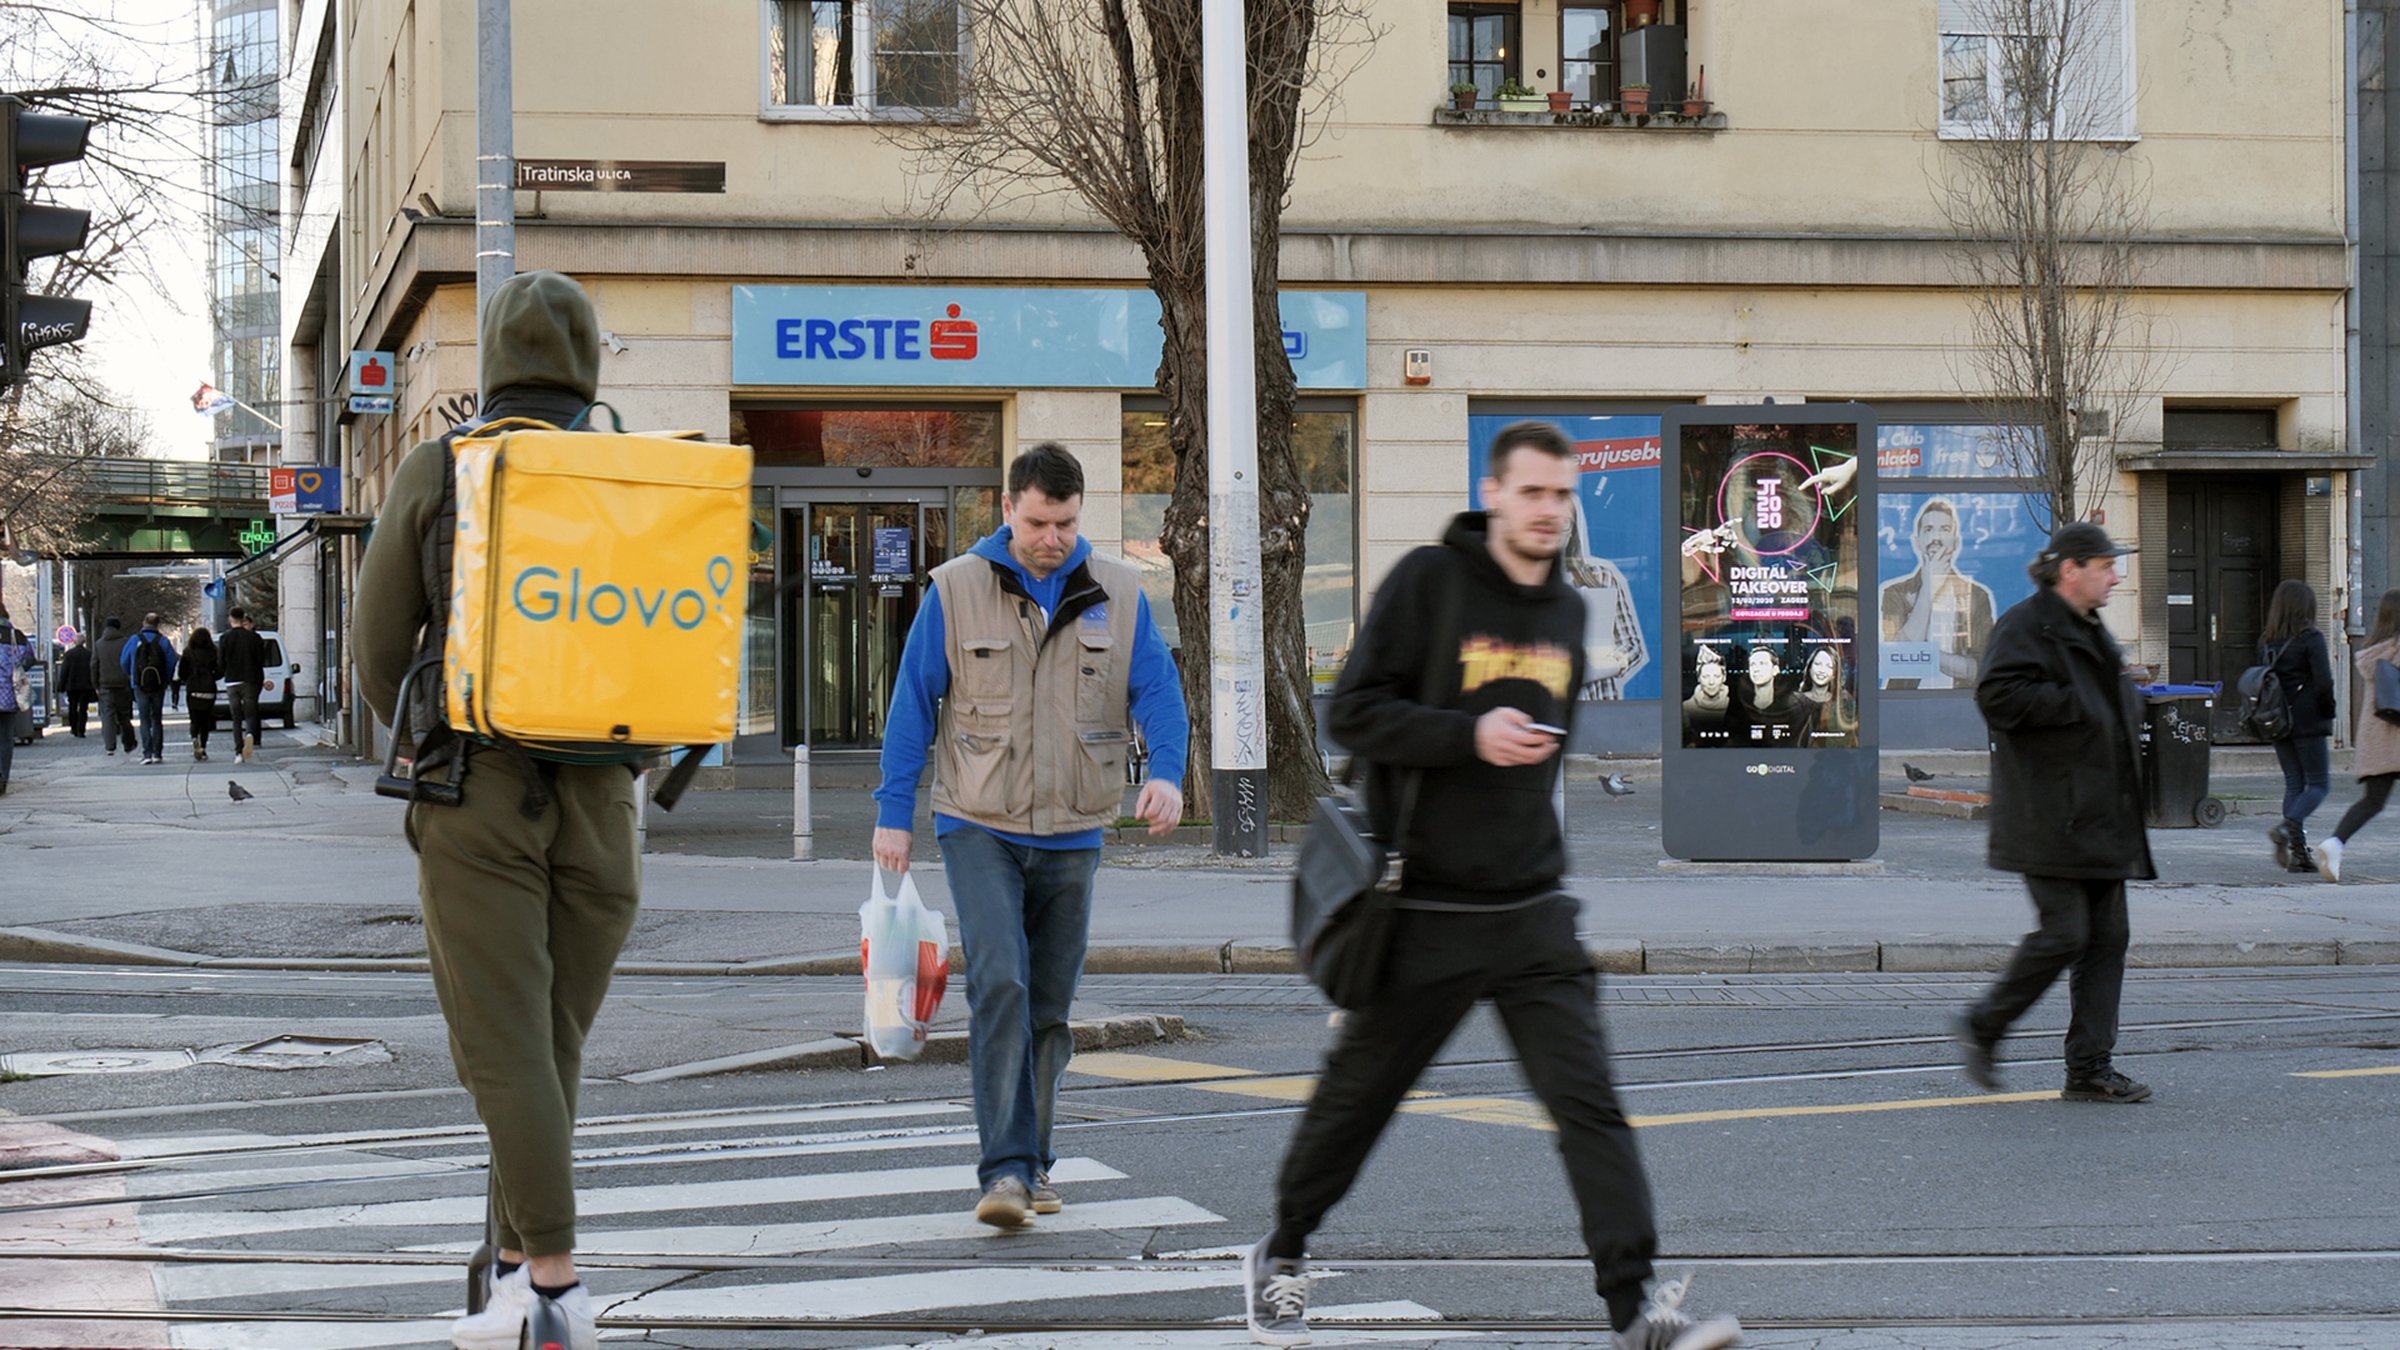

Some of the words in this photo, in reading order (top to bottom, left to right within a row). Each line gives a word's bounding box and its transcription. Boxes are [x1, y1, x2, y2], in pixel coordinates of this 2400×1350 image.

[523, 166, 594, 182] Tratinska
[597, 170, 631, 180] ULICA
[777, 318, 921, 359] ERSTE
[1891, 430, 1924, 446] Club
[1757, 496, 1782, 512] 20
[1757, 513, 1782, 528] 20
[1730, 567, 1788, 579] DIGITAL
[1730, 582, 1808, 594] TAKEOVER
